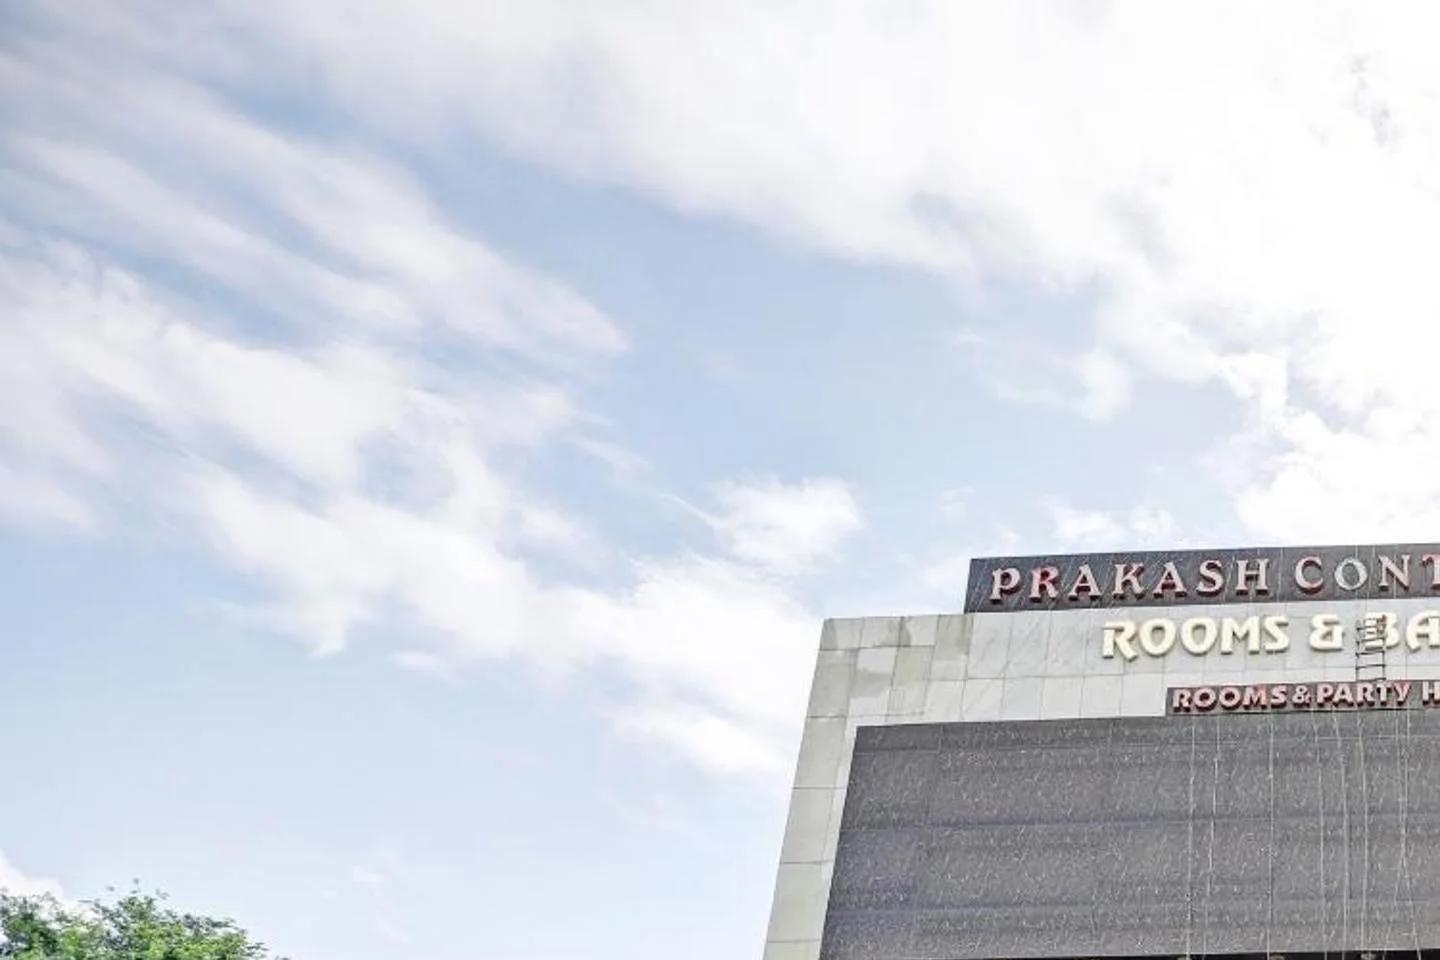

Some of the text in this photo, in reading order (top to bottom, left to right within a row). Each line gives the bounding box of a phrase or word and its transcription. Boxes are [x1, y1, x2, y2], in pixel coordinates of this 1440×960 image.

[989, 557, 1270, 603] PRAKASH
[1102, 613, 1290, 662] ROOMS
[1308, 612, 1346, 651] &
[1172, 683, 1289, 713] ROOMS
[1316, 679, 1412, 708] PARTY
